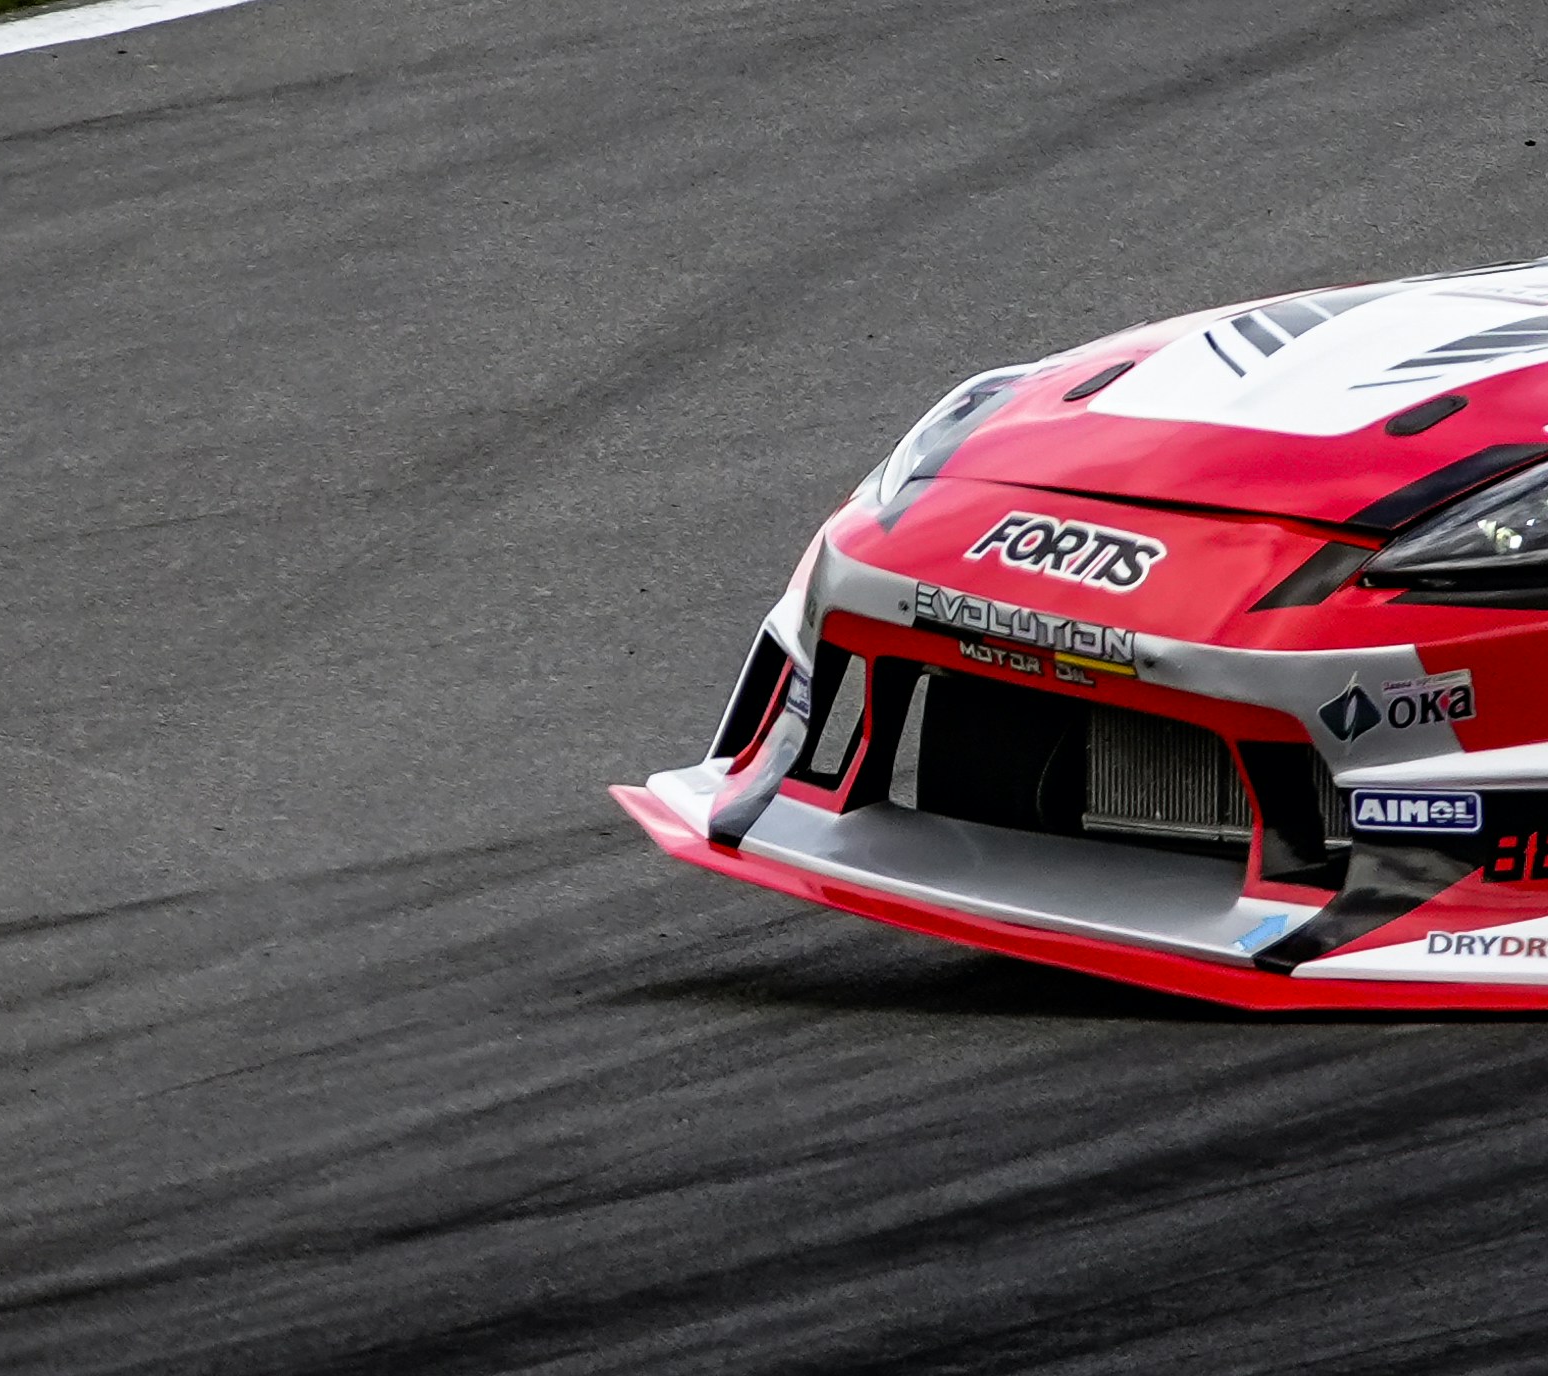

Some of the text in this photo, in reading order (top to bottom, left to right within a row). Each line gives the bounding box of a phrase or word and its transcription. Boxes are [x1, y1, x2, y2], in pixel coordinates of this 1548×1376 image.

[969, 513, 1163, 589] FORTIS
[915, 582, 1135, 662] EVOLUTION
[959, 639, 1095, 686] MOTOR OIL
[1357, 798, 1474, 824] AIMOL
